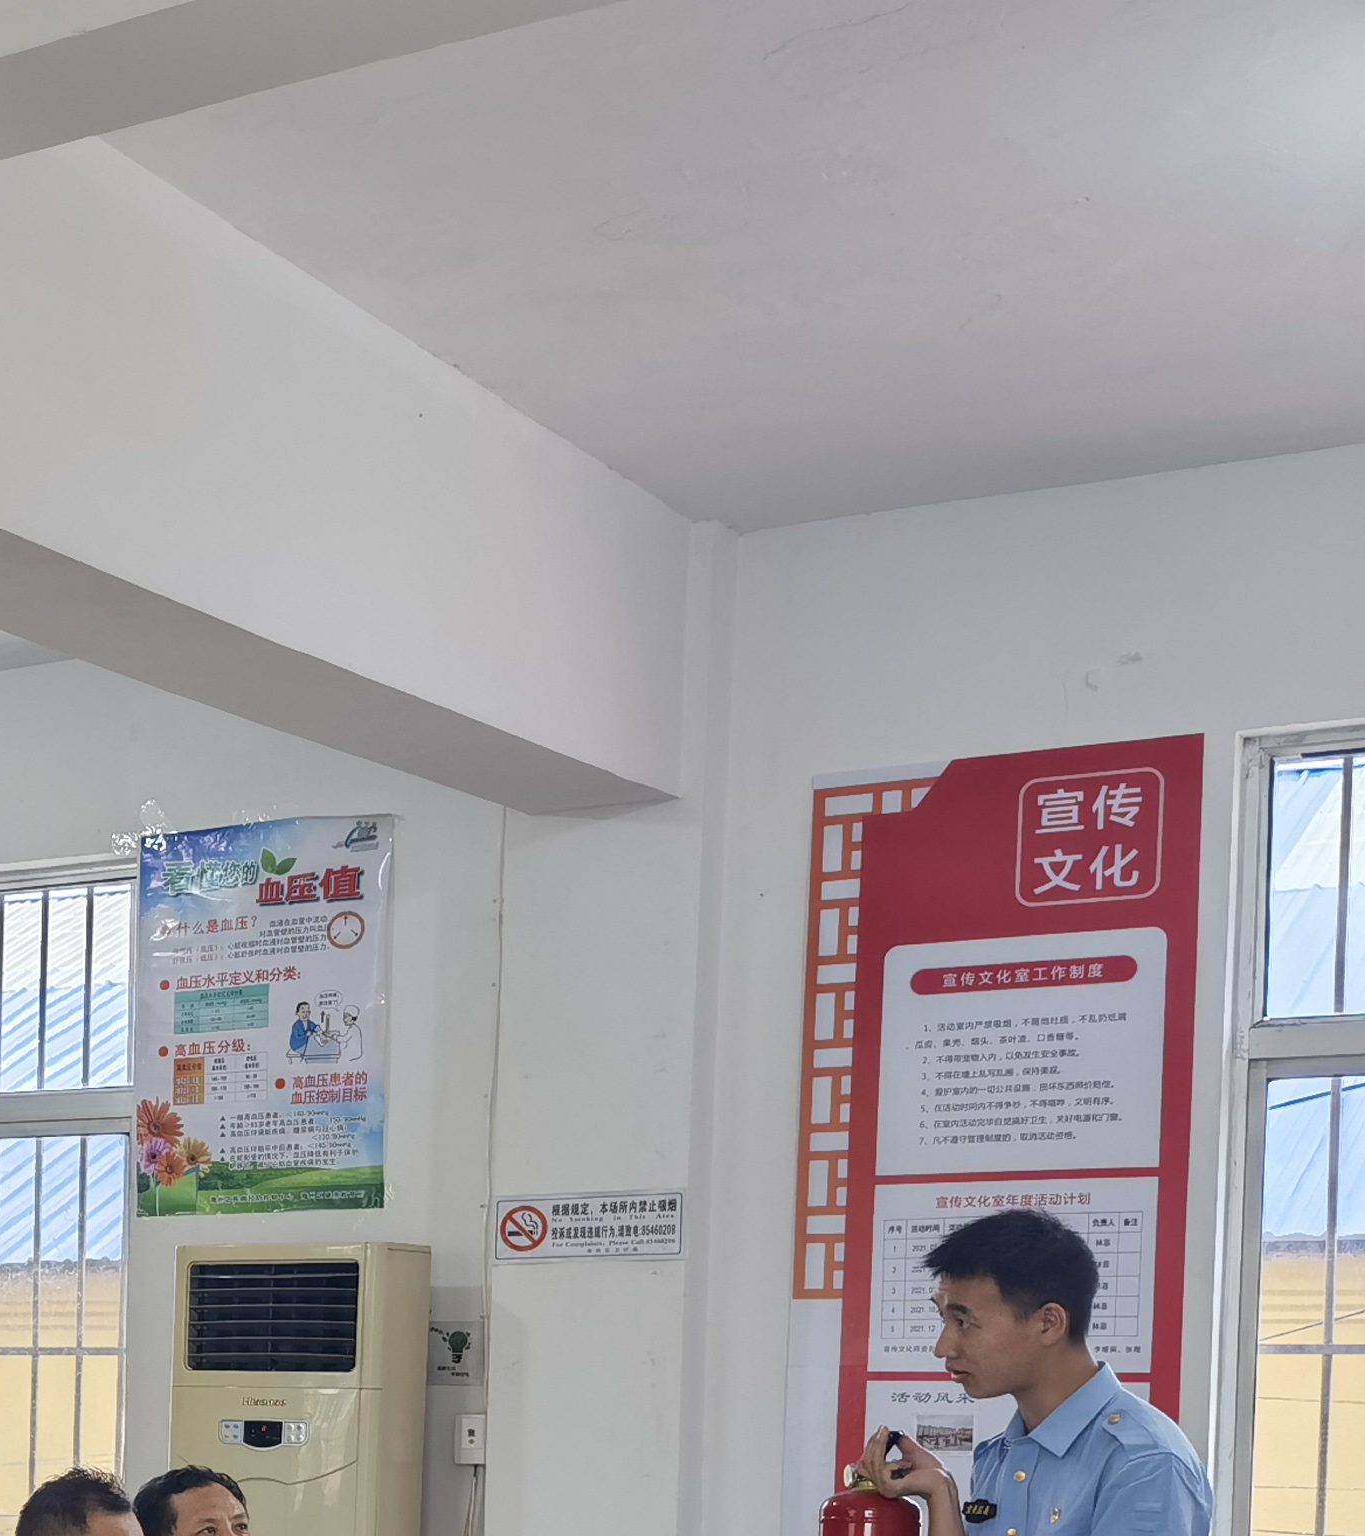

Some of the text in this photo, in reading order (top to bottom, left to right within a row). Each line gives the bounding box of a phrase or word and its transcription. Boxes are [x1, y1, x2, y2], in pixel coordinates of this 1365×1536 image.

[1035, 782, 1143, 835] 宣传
[1033, 844, 1140, 895] 文化
[256, 864, 365, 906] 血压值
[942, 963, 1104, 989] 宣传文化室工作制度
[292, 1071, 368, 1089] 高血压患者的
[291, 1086, 368, 1105] 血压控制目标
[936, 1192, 1091, 1209] 宣传文化室年度活动计划
[891, 1391, 975, 1404] 活动风采
